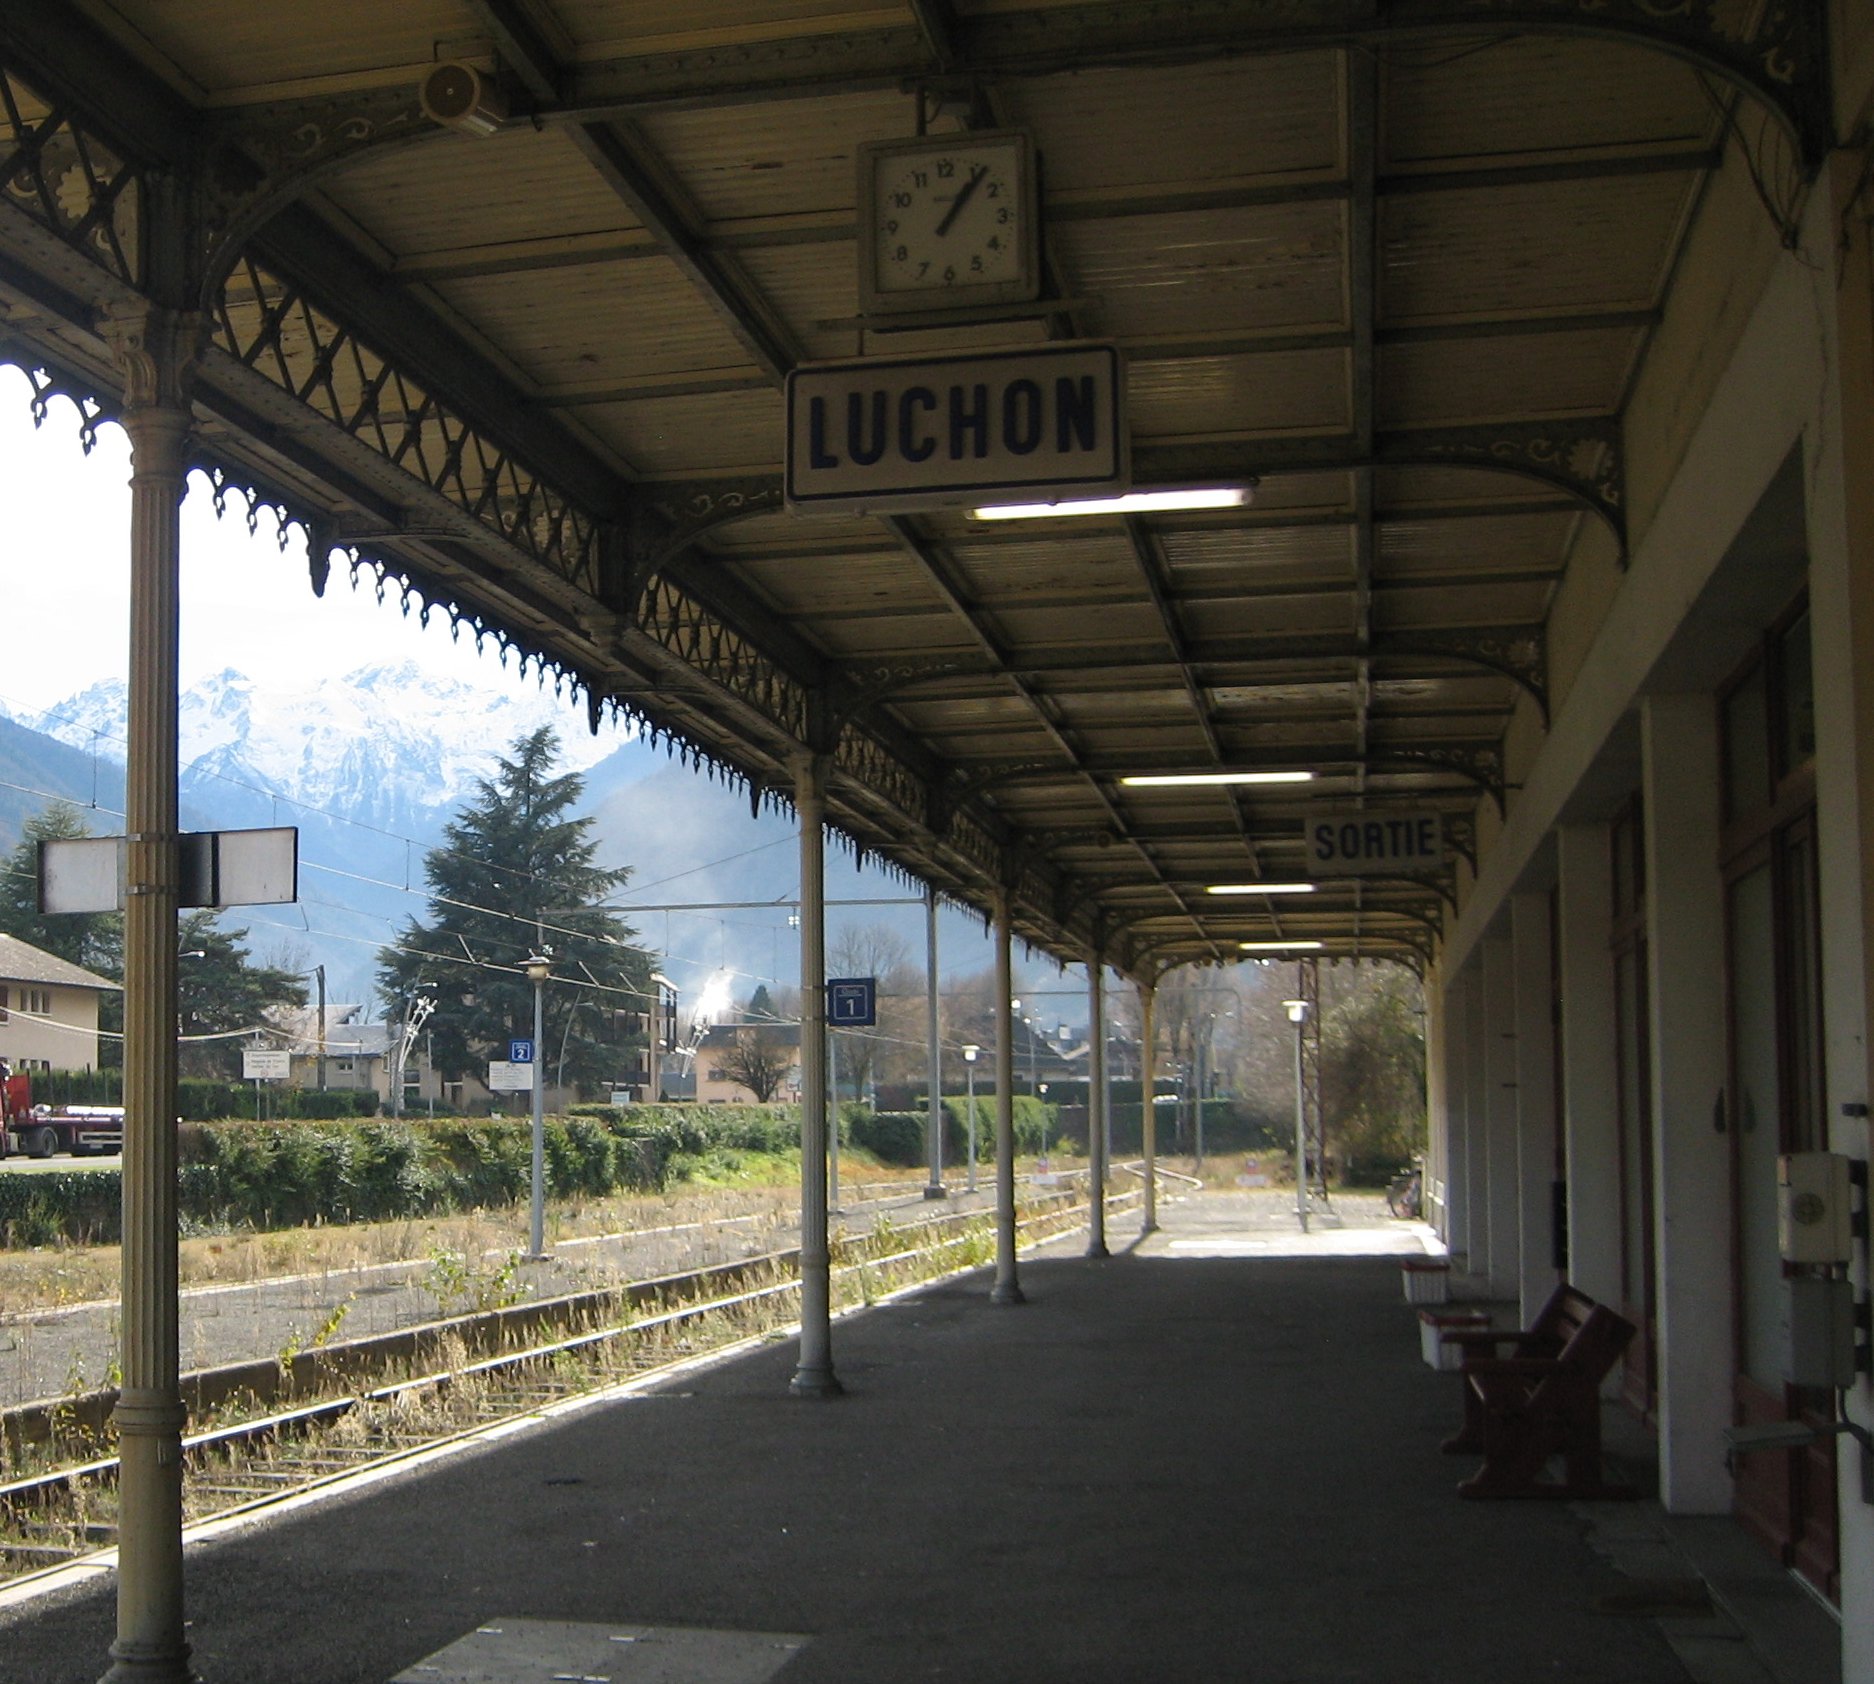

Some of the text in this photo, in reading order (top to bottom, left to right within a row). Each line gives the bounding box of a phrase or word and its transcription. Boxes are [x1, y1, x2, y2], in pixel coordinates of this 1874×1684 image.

[936, 159, 954, 178] 12
[914, 172, 927, 188] 11
[986, 182, 998, 198] 2
[894, 192, 912, 208] 10
[997, 208, 1008, 224] 3
[888, 220, 898, 235] 9
[987, 236, 999, 250] 4
[897, 245, 908, 261] 8
[919, 262, 930, 277] 7
[970, 255, 982, 271] 5
[944, 265, 955, 281] 6
[810, 375, 1095, 469] LUCHON
[1315, 819, 1436, 860] SORTIE
[846, 999, 855, 1016] 1
[517, 1049, 525, 1059] 2
